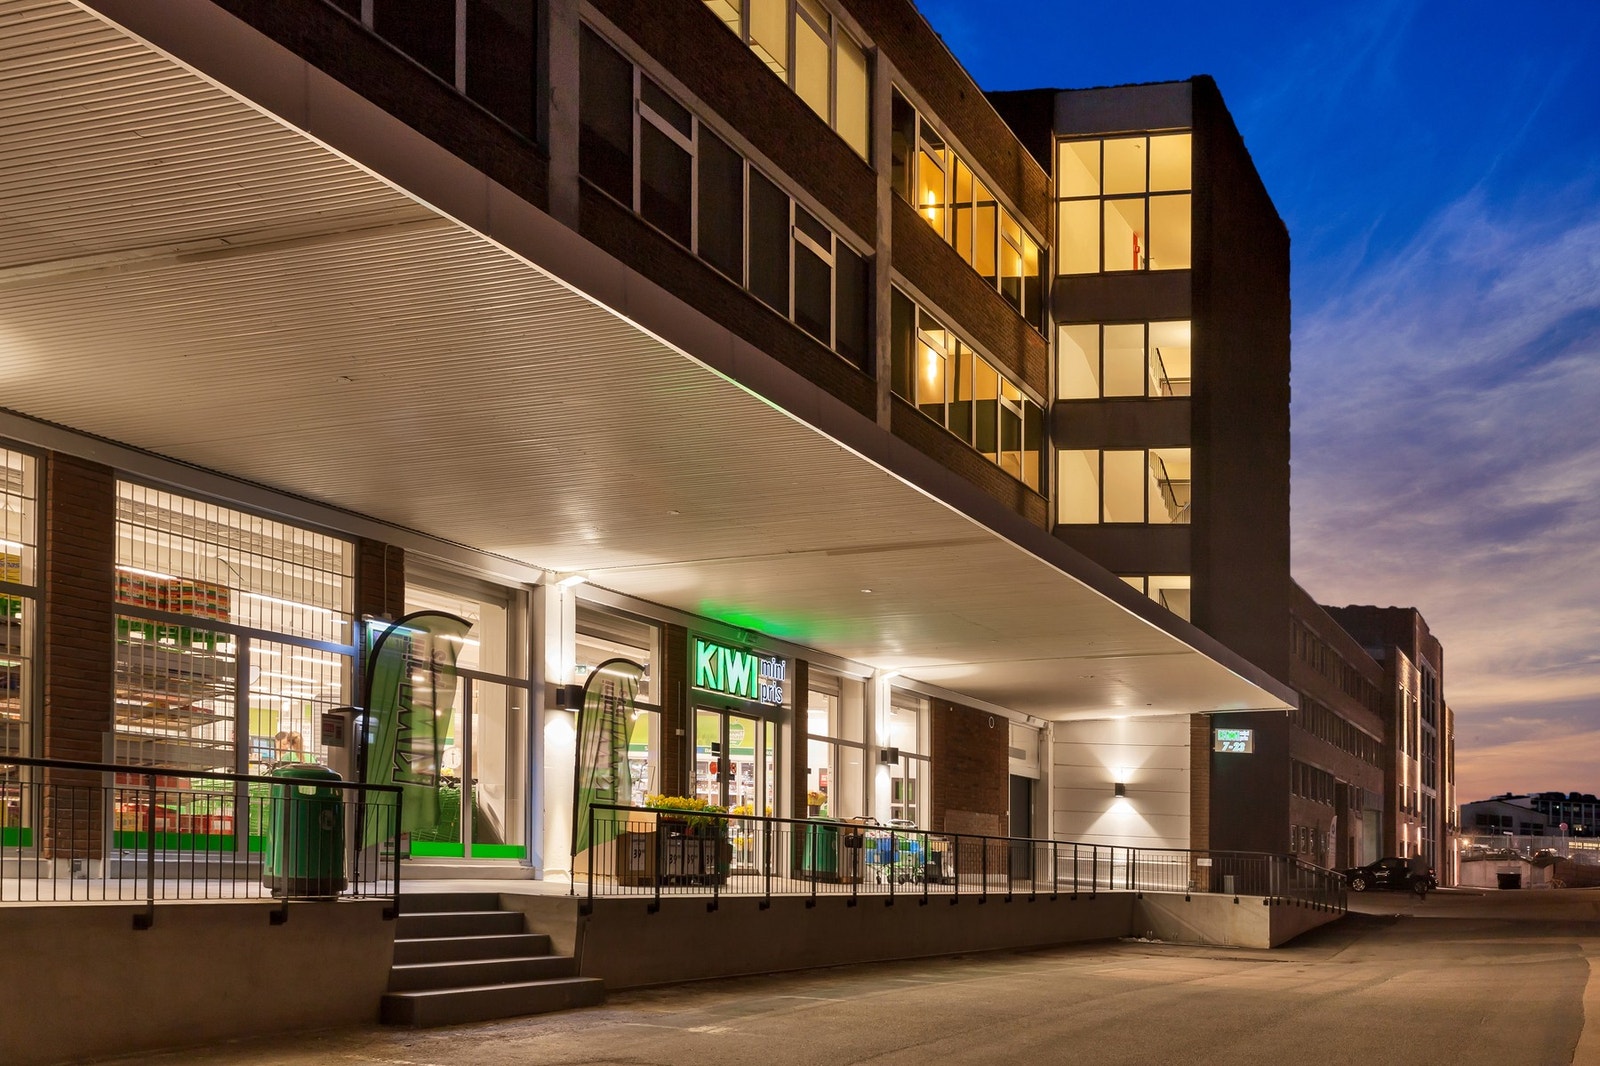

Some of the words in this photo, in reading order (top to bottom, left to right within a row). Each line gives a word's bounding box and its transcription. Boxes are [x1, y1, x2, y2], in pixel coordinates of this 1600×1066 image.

[697, 640, 758, 699] KIWI
[761, 657, 786, 681] mini
[761, 681, 783, 704] pris
[392, 683, 437, 787] KIWI
[1222, 741, 1246, 752] 7-23
